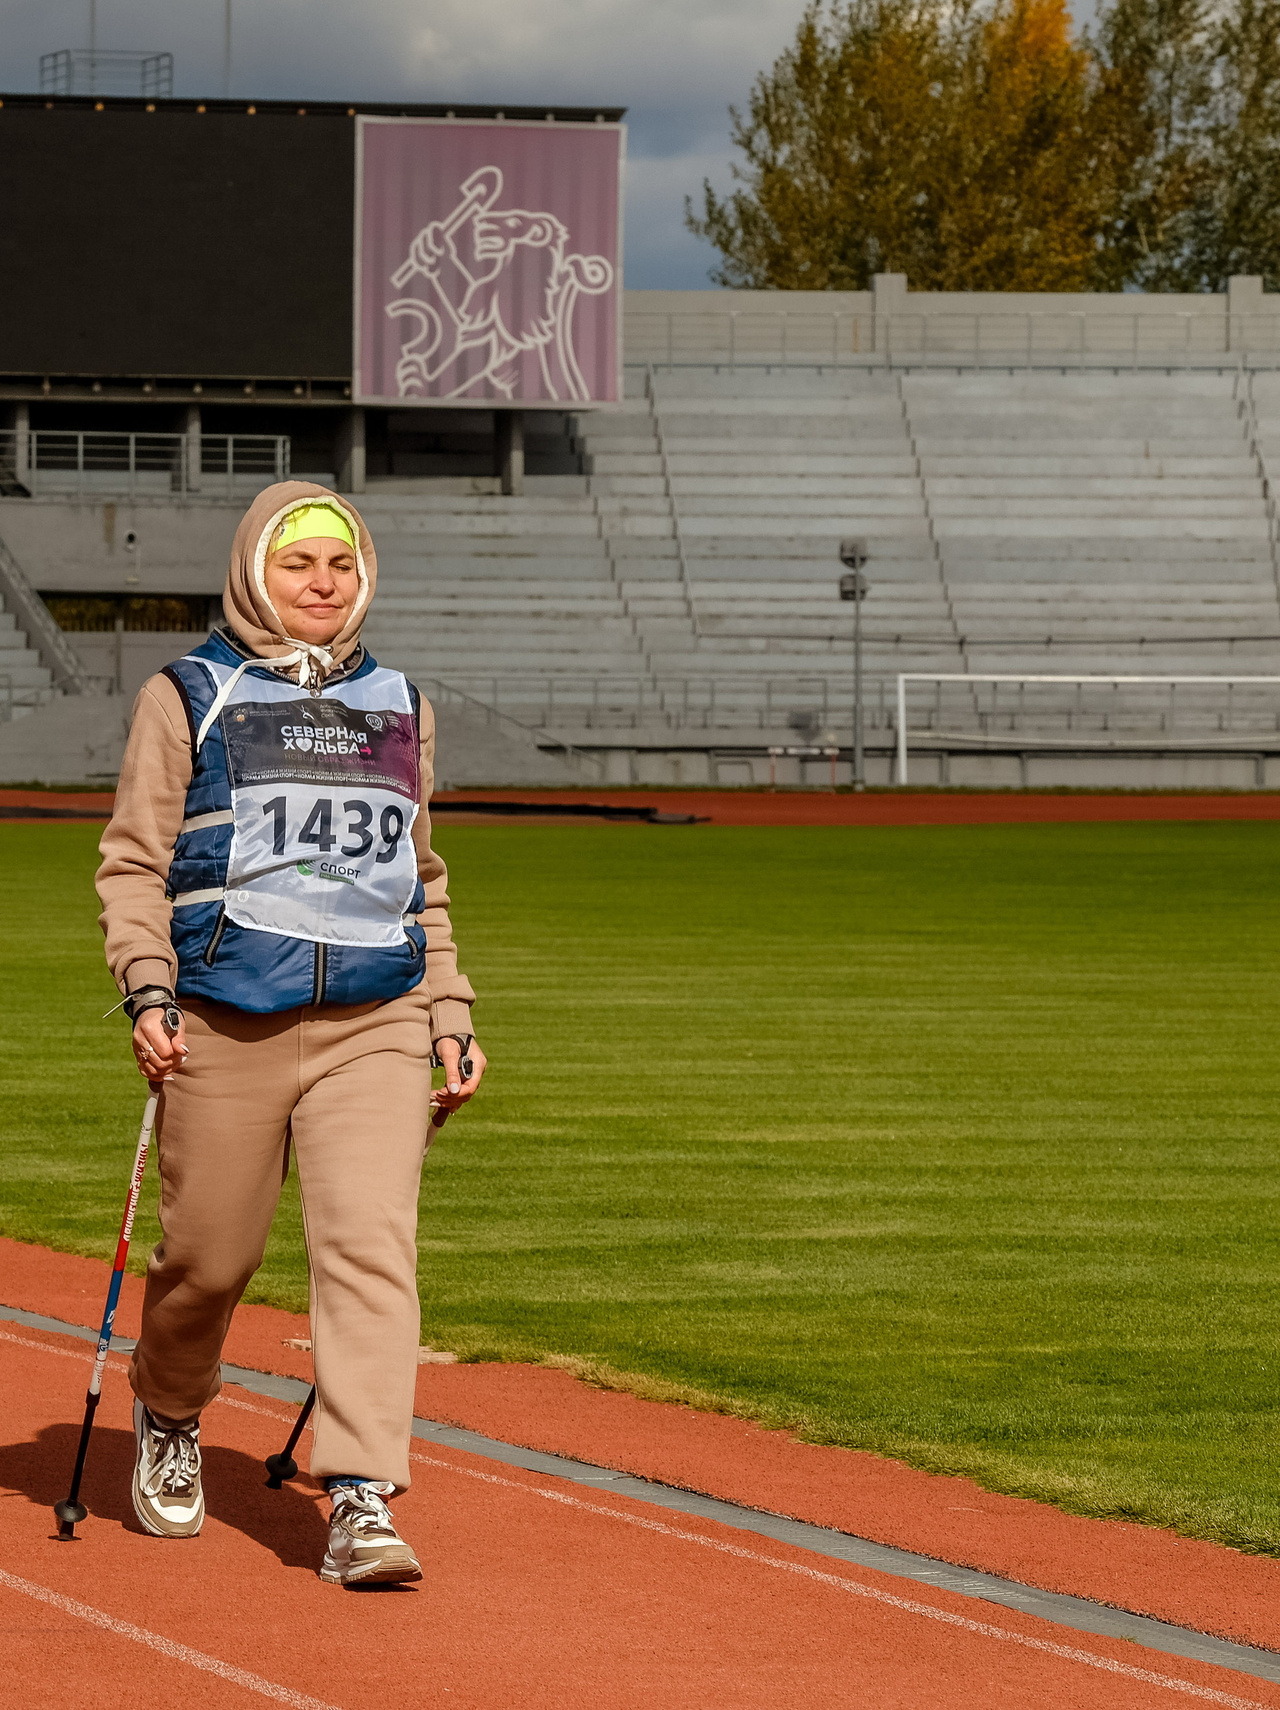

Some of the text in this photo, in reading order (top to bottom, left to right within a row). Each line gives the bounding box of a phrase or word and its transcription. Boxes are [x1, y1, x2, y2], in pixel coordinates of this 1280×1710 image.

[280, 725, 368, 744] СЕВЕРНАЯ
[284, 752, 316, 762] НОВЫЙ
[262, 796, 404, 864] 1439
[320, 862, 361, 879] СПОРТ
